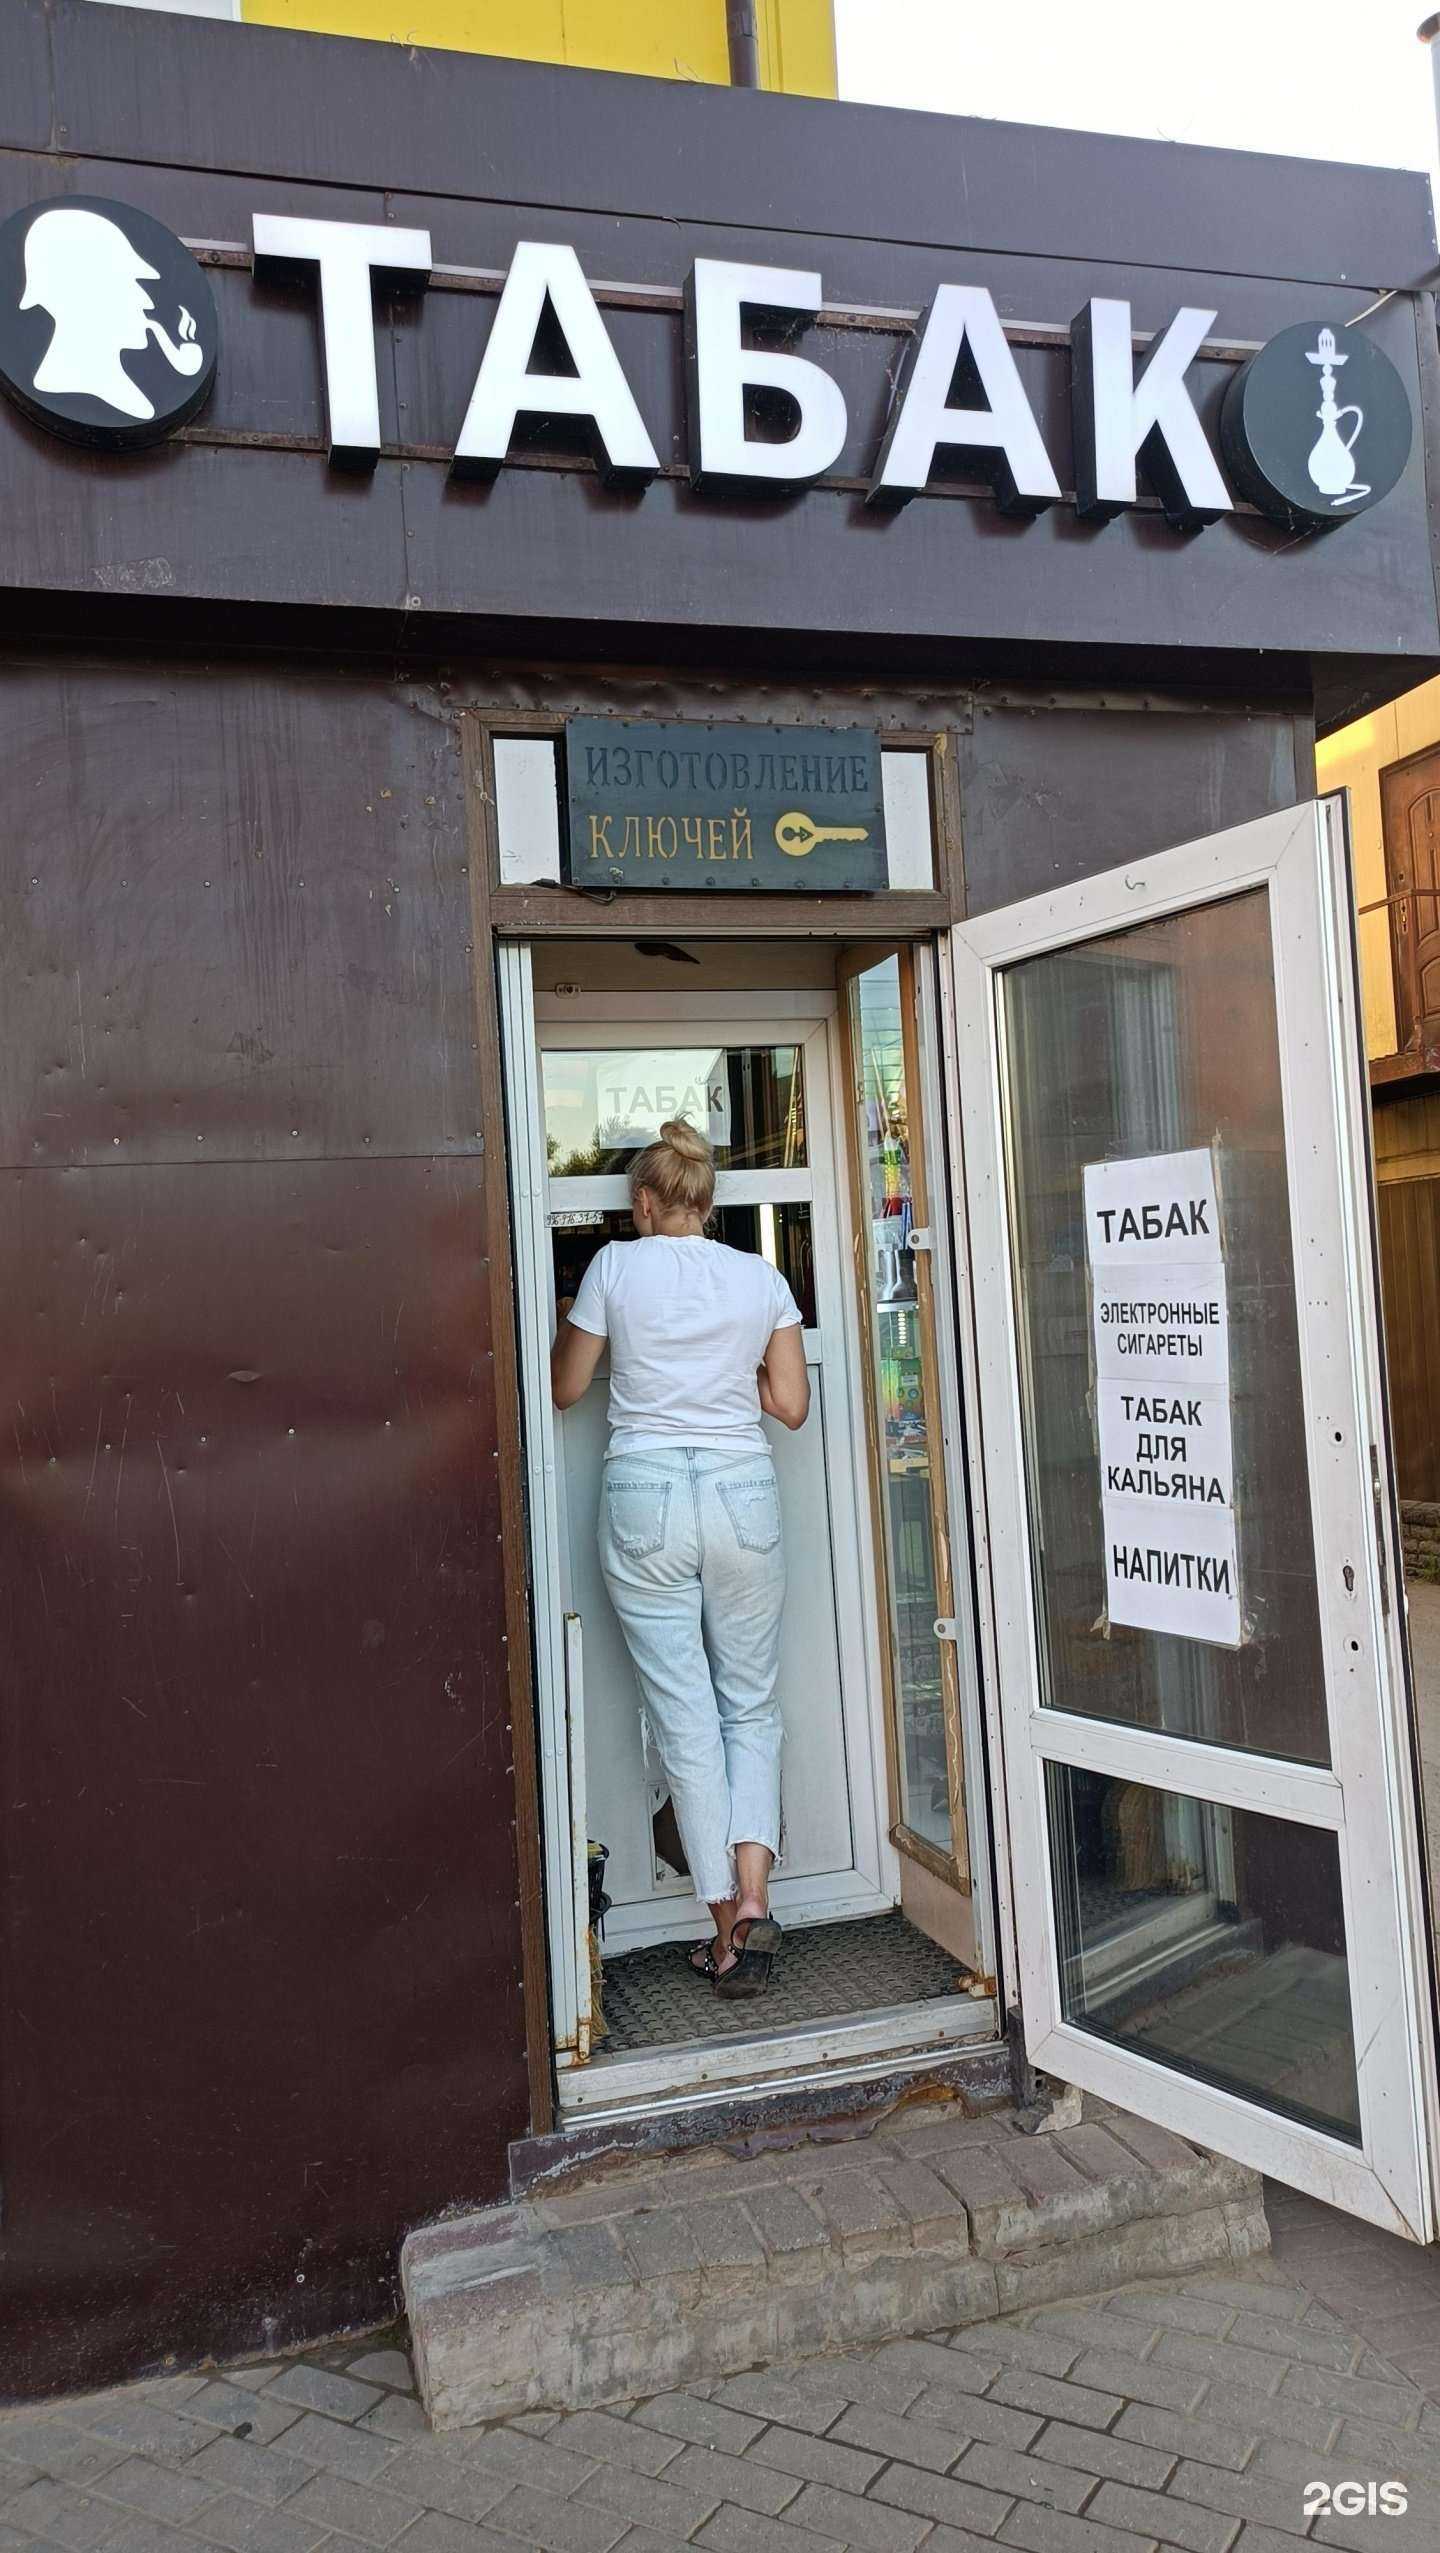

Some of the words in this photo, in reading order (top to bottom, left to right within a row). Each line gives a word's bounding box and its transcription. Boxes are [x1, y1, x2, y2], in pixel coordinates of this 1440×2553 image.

[251, 211, 1235, 514] ТАБАК
[584, 746, 869, 794] ИЗГОТОВЛЕНИЕ
[588, 807, 753, 861] КЛЮЧЕЙ
[605, 1085, 724, 1113] ТАБАК
[1096, 1199, 1210, 1243] ТАБАК
[1100, 1302, 1220, 1325] ЭЛЕКТРОННЫЕ
[1117, 1333, 1203, 1357] СИГАРЕТЫ
[1120, 1396, 1203, 1426] ТАБАК
[1136, 1433, 1187, 1463] ДЛЯ
[1107, 1465, 1226, 1504] КАЛЬЯНА
[1113, 1544, 1230, 1595] НАПИТКИ
